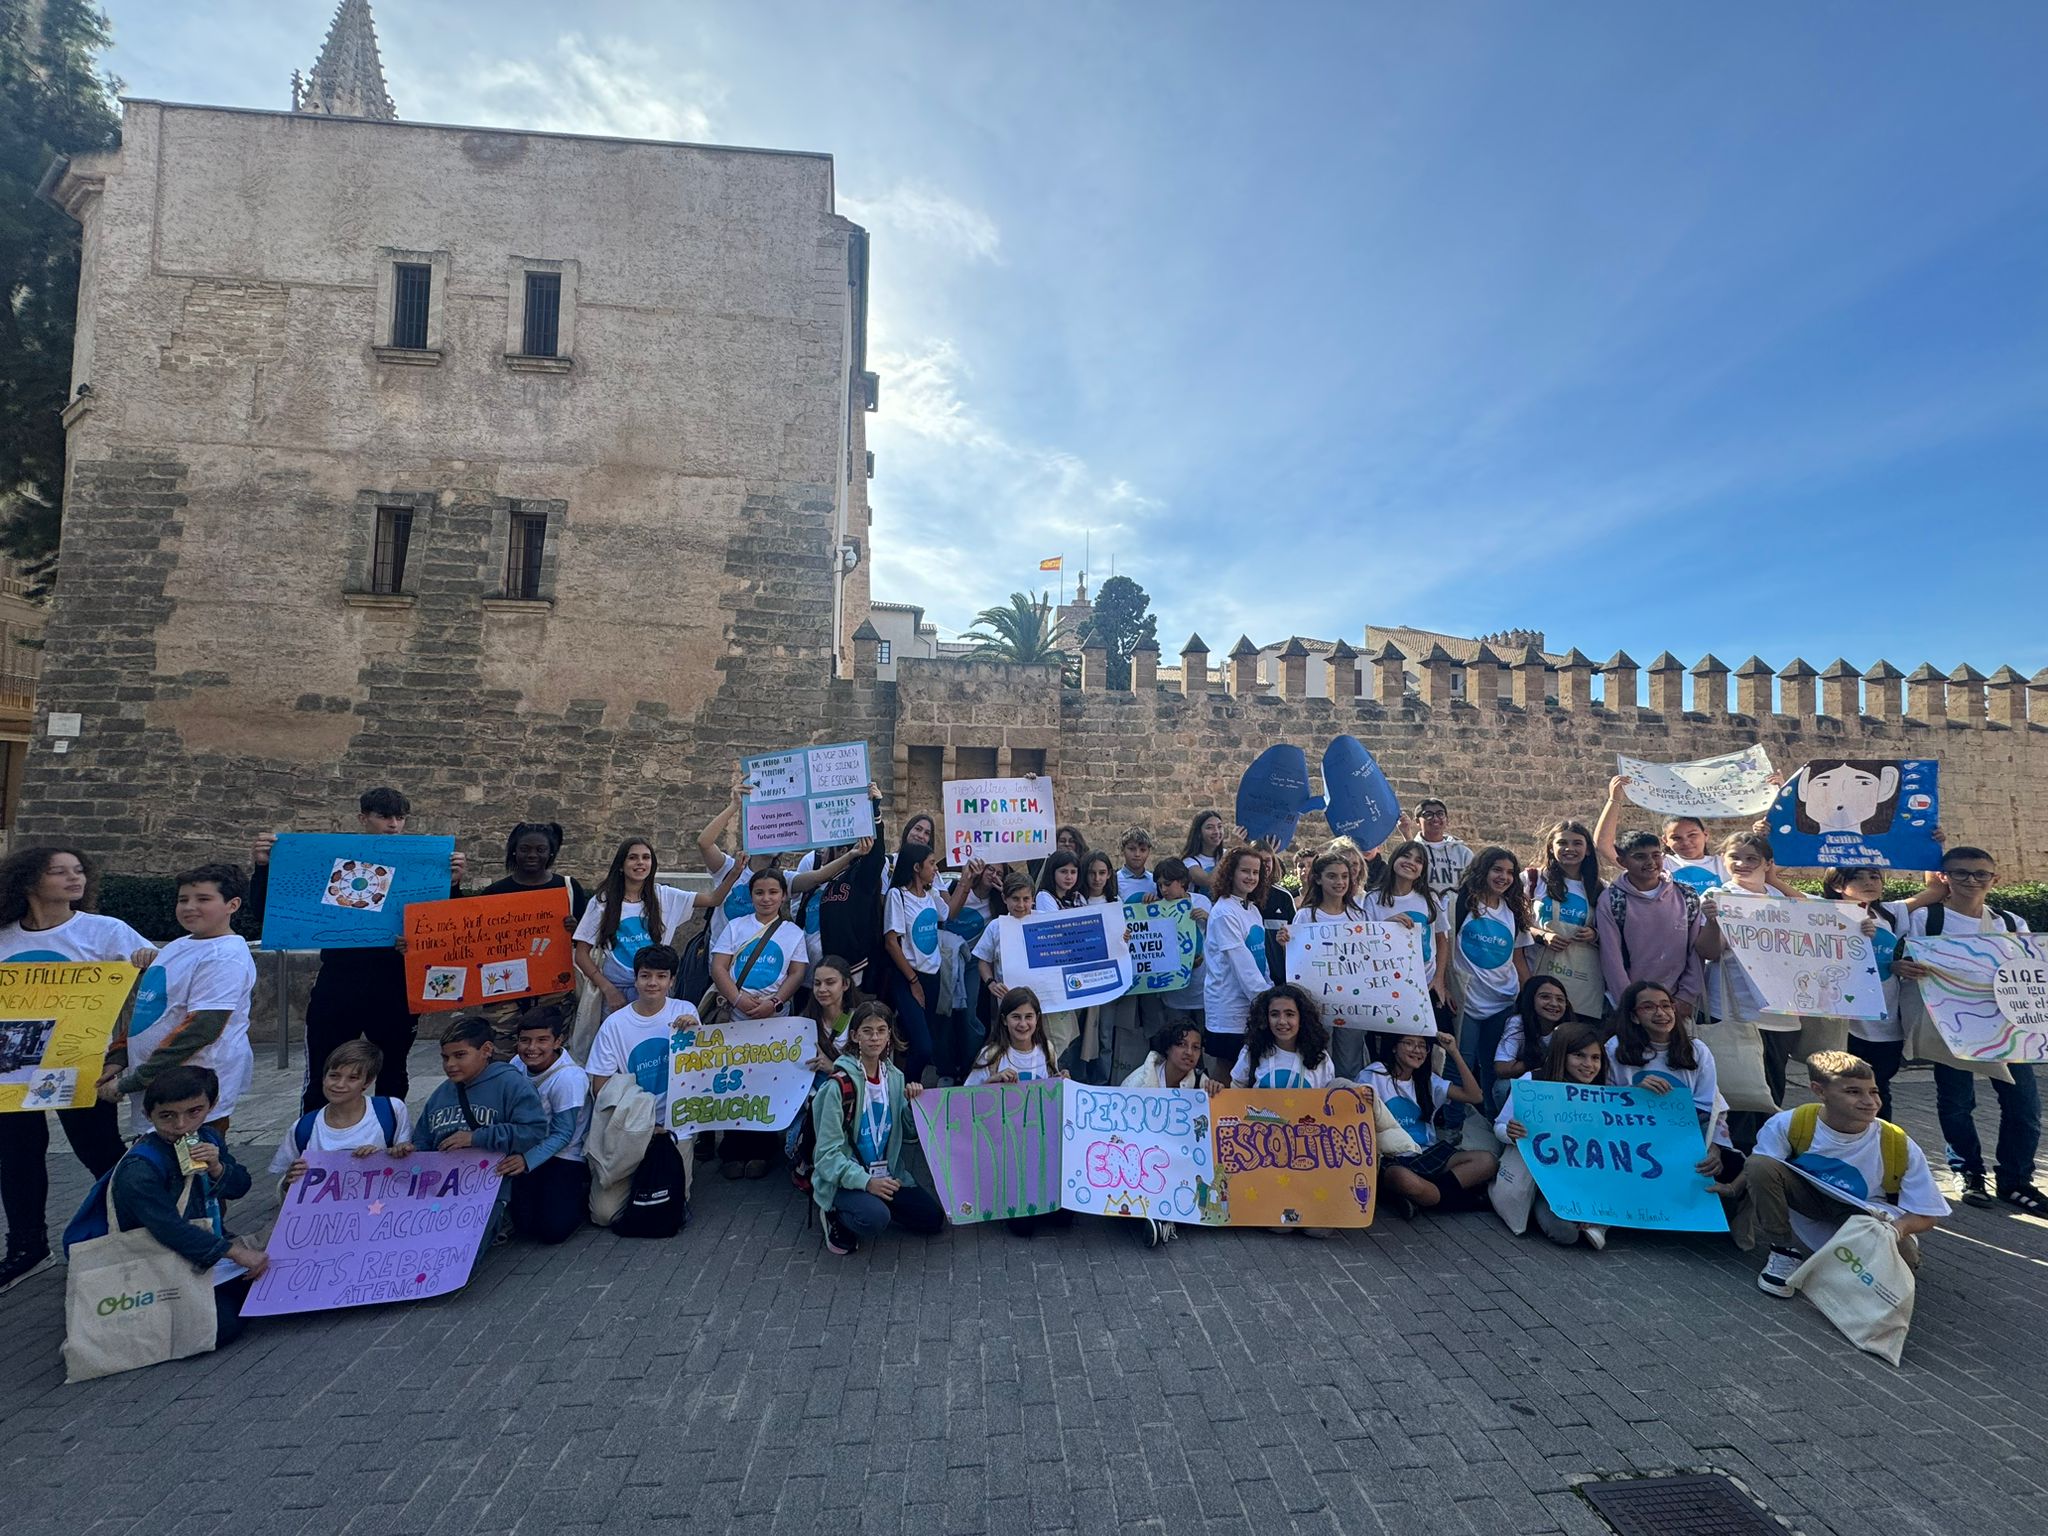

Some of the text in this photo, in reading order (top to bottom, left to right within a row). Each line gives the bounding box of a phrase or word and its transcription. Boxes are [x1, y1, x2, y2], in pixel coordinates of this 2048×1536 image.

[812, 752, 821, 762] LA
[812, 764, 822, 772] NO
[826, 762, 832, 772] SE
[952, 780, 1008, 795] nosaltres
[1730, 788, 1756, 796] SOM
[957, 798, 1043, 814] IMPORTEM,
[761, 812, 776, 820] Veus
[750, 822, 778, 831] decisions
[956, 829, 1048, 845] PARTICIPEM!
[437, 918, 457, 932] més
[536, 910, 554, 920] nins
[1126, 922, 1148, 932] SOM
[1756, 909, 1791, 924] NINS
[1808, 913, 1837, 927] SOM
[421, 936, 447, 950] nines
[495, 930, 511, 942] que
[1304, 922, 1386, 940] TOTS ELS
[1469, 932, 1497, 944] unicef
[1140, 940, 1162, 952] VEU
[1322, 940, 1392, 957] INFANTS
[1723, 922, 1867, 961] IMPORTANTS
[444, 947, 475, 962] adults
[1136, 962, 1152, 973] DE
[1372, 956, 1405, 972] DRET
[1324, 976, 1392, 996] A SER
[1996, 986, 2018, 996] som
[44, 994, 104, 1010] DRETS
[1321, 1002, 1401, 1018] ESCOLTATS
[2009, 1000, 2030, 1012] que
[670, 1028, 724, 1054] #LA
[674, 1036, 802, 1074] PARTICIPACIÓ
[712, 1066, 744, 1094] ÉS
[1517, 1081, 1554, 1102] Som
[1566, 1085, 1636, 1107] PETITS
[428, 1104, 499, 1134] BENETON
[672, 1094, 776, 1128] ESENCIAL
[1076, 1088, 1193, 1136] PERQUÈ
[1522, 1106, 1544, 1123] els
[1554, 1110, 1594, 1123] nostres
[1602, 1110, 1657, 1127] DRETS
[1217, 1121, 1374, 1173] ESCOLTIN!
[1532, 1132, 1664, 1180] GRANS
[1086, 1140, 1170, 1194] ENS
[285, 1202, 494, 1250] UNA ACCIÓ ON
[256, 1244, 471, 1302] TOTS REBREM
[1833, 1246, 1874, 1287] Obia
[333, 1270, 440, 1305] ATENCIÓ
[96, 1290, 154, 1316] Obia
